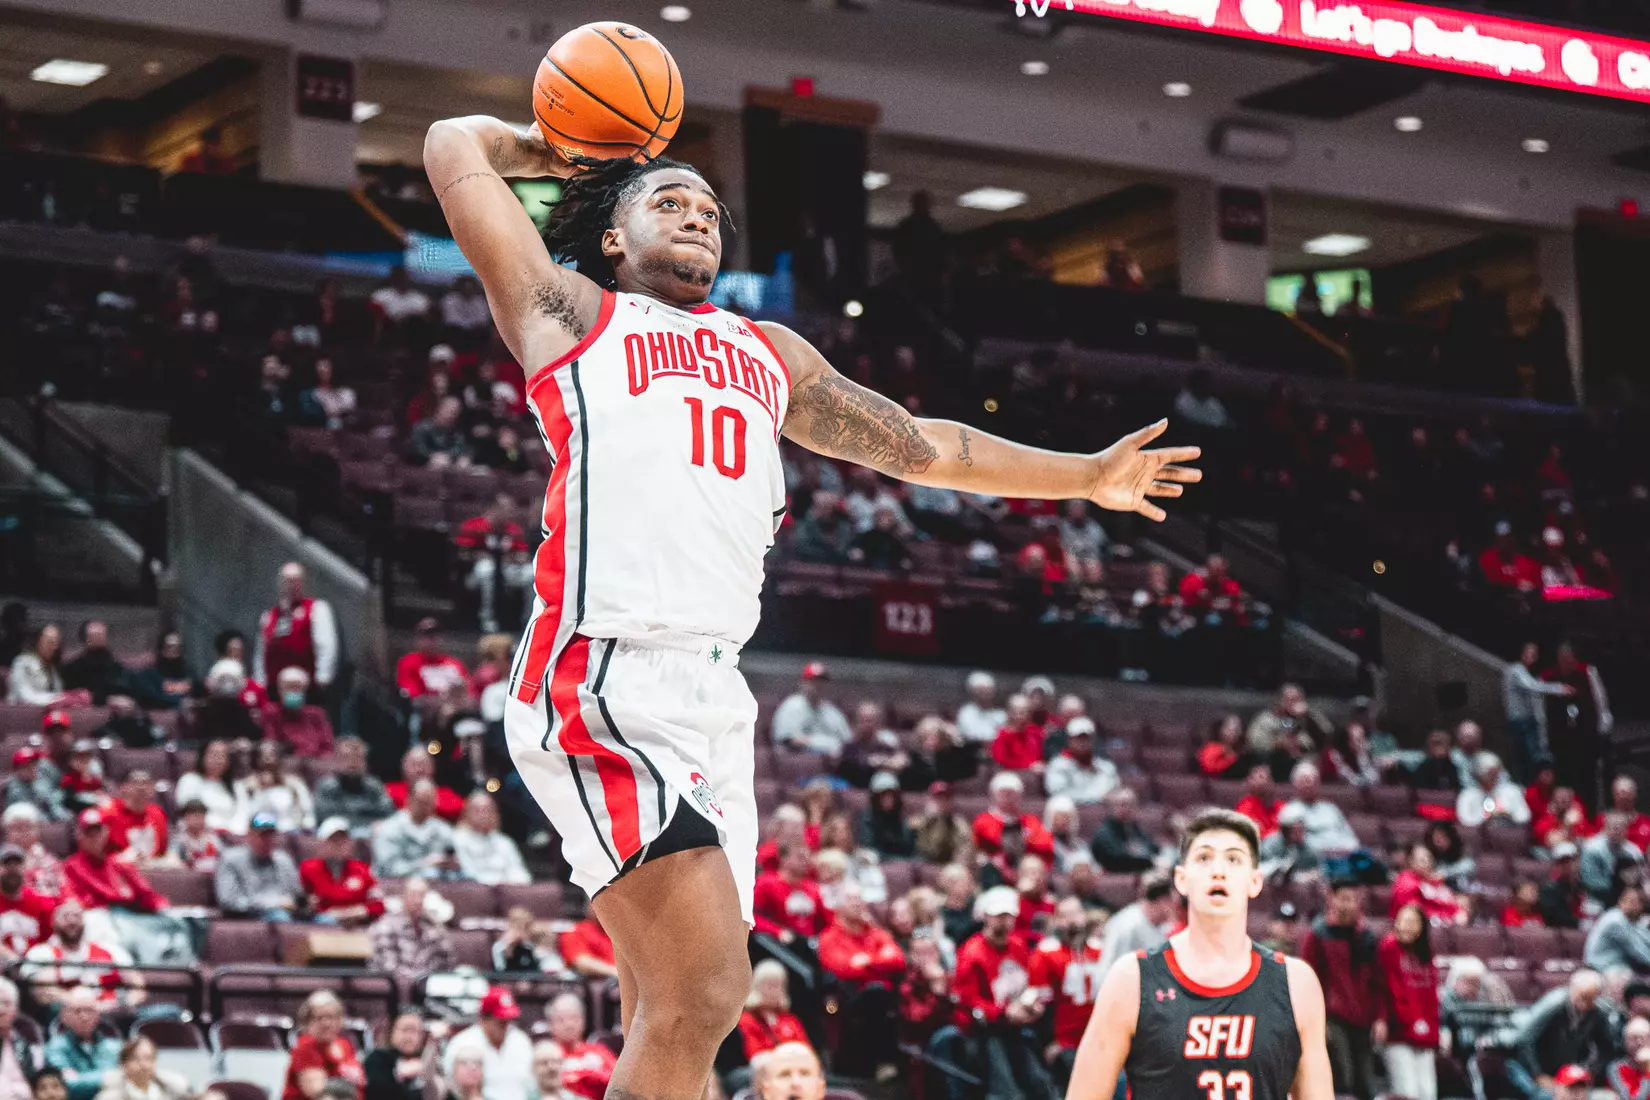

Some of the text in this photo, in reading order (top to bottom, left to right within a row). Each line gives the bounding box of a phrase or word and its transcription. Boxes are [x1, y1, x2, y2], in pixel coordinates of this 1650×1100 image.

[624, 332, 699, 397] OHIO
[684, 396, 747, 480] 10
[885, 601, 933, 635] 123
[1183, 1016, 1256, 1059] SFU
[1197, 1070, 1253, 1100] 33
